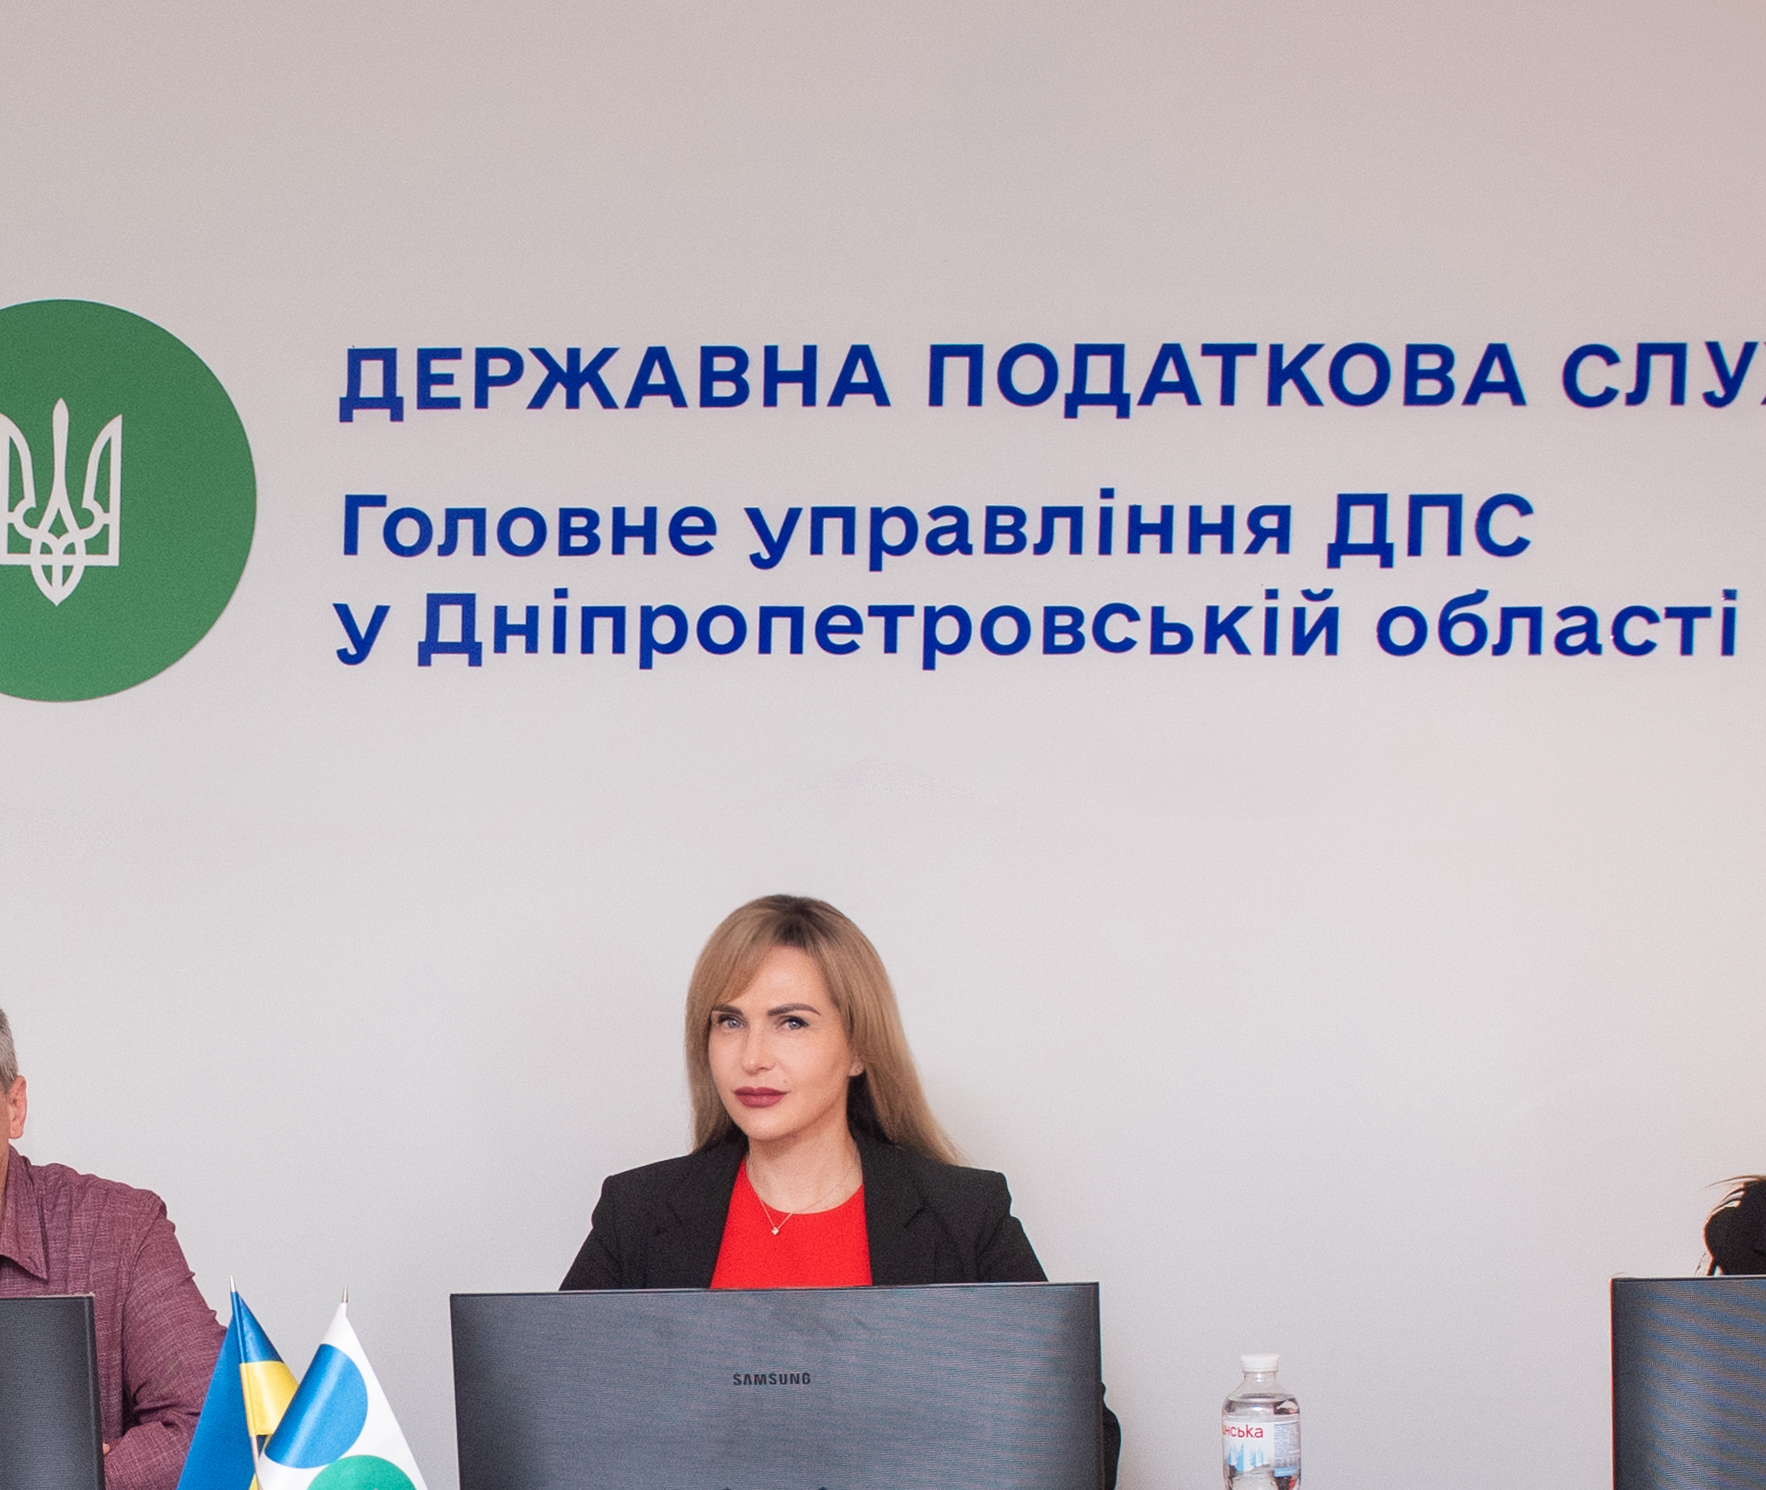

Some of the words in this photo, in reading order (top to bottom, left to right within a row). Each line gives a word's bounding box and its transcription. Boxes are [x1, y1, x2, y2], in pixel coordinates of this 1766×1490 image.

[340, 344, 891, 422] ДЕРЖАВНА
[929, 342, 1527, 419] ПОДАТКОВА
[342, 493, 717, 556] Головне
[746, 487, 1292, 572] управління
[1327, 493, 1535, 569] ДПС
[333, 603, 391, 666] у
[417, 587, 1340, 671] Дніпропетровській
[1375, 588, 1739, 657] області
[733, 1372, 811, 1386] SAMSUNG
